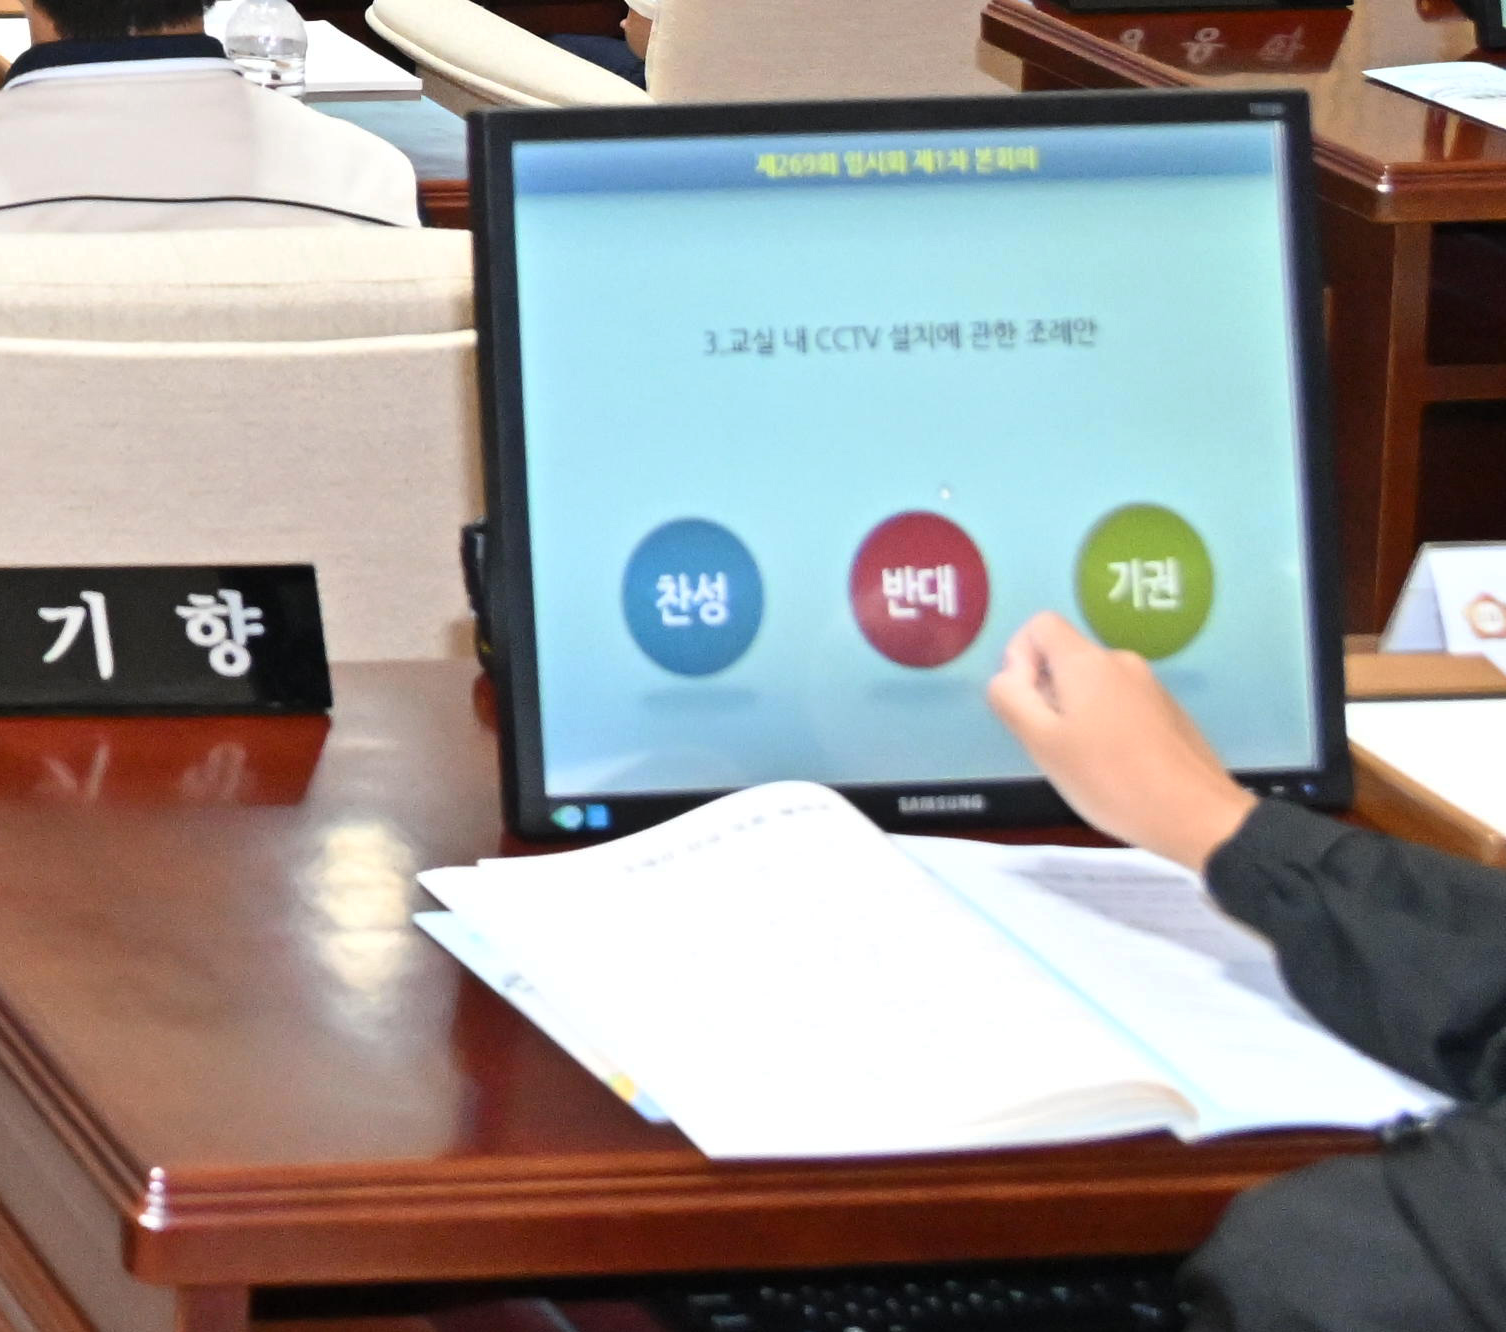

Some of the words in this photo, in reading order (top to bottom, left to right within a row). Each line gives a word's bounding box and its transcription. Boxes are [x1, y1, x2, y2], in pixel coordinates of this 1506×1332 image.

[815, 324, 882, 352] CCTV
[655, 575, 730, 628] 찬성
[881, 566, 958, 619] 반대
[1107, 559, 1182, 612] 기권
